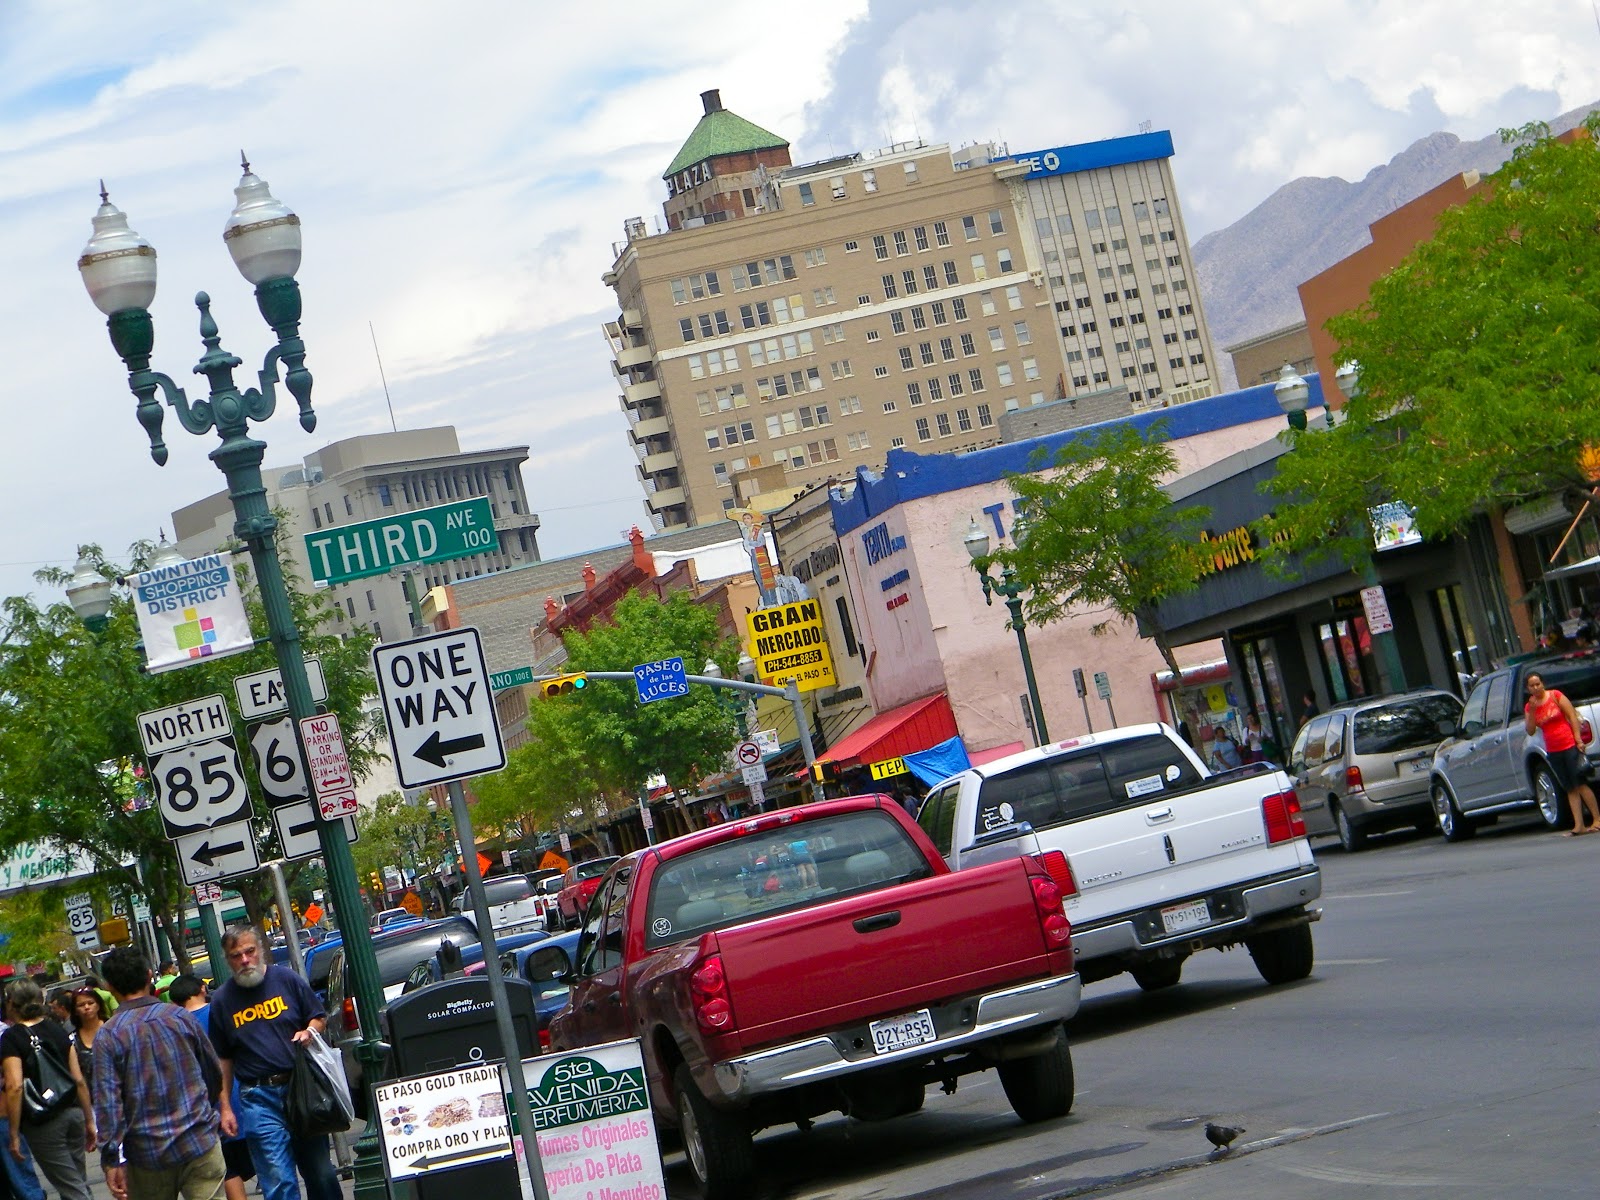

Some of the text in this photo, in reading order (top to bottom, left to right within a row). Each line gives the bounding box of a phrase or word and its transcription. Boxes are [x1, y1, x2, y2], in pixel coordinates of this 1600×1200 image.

[665, 161, 713, 200] PLAZA
[445, 508, 476, 531] AVE
[311, 518, 438, 578] THIRD
[462, 527, 491, 549] 100
[139, 555, 221, 585] DWNTWN
[145, 571, 222, 599] SHOPPING
[148, 585, 228, 615] DISTRICT
[752, 603, 817, 632] GRAN
[756, 626, 821, 656] MERCADO
[391, 642, 472, 688] ONE
[636, 660, 682, 681] PASEO
[649, 673, 673, 683] de las
[796, 673, 803, 682] EL
[804, 669, 819, 680] PASO
[249, 679, 287, 707] EA
[394, 681, 477, 729] WAY
[640, 682, 686, 702] LUCES
[144, 704, 225, 746] NORTH
[307, 731, 340, 746] PARKING
[311, 720, 328, 734] NO
[266, 738, 296, 782] 6
[312, 753, 344, 768] STANDING
[319, 745, 332, 755] OR
[165, 755, 235, 812] 85
[543, 858, 560, 868] ROAD
[1082, 870, 1122, 885] LINCOLN
[65, 895, 90, 907] NORTH
[71, 911, 93, 928] 85
[233, 995, 288, 1028] NORML
[427, 1000, 495, 1020] SOLAR COMPACTOR
[446, 999, 473, 1008] BigBelly
[554, 1061, 593, 1082] 5ta
[377, 1090, 389, 1102] EL
[393, 1081, 422, 1098] PASO
[425, 1075, 456, 1090] GOLD
[527, 1071, 639, 1107] AVENIDA
[533, 1092, 644, 1129] ERFUMERIA
[392, 1138, 442, 1159] COMPRA
[445, 1131, 469, 1148] ORO
[472, 1130, 480, 1142] Y
[581, 1117, 649, 1151] Originales
[544, 1151, 643, 1195] oyeria De Plata
